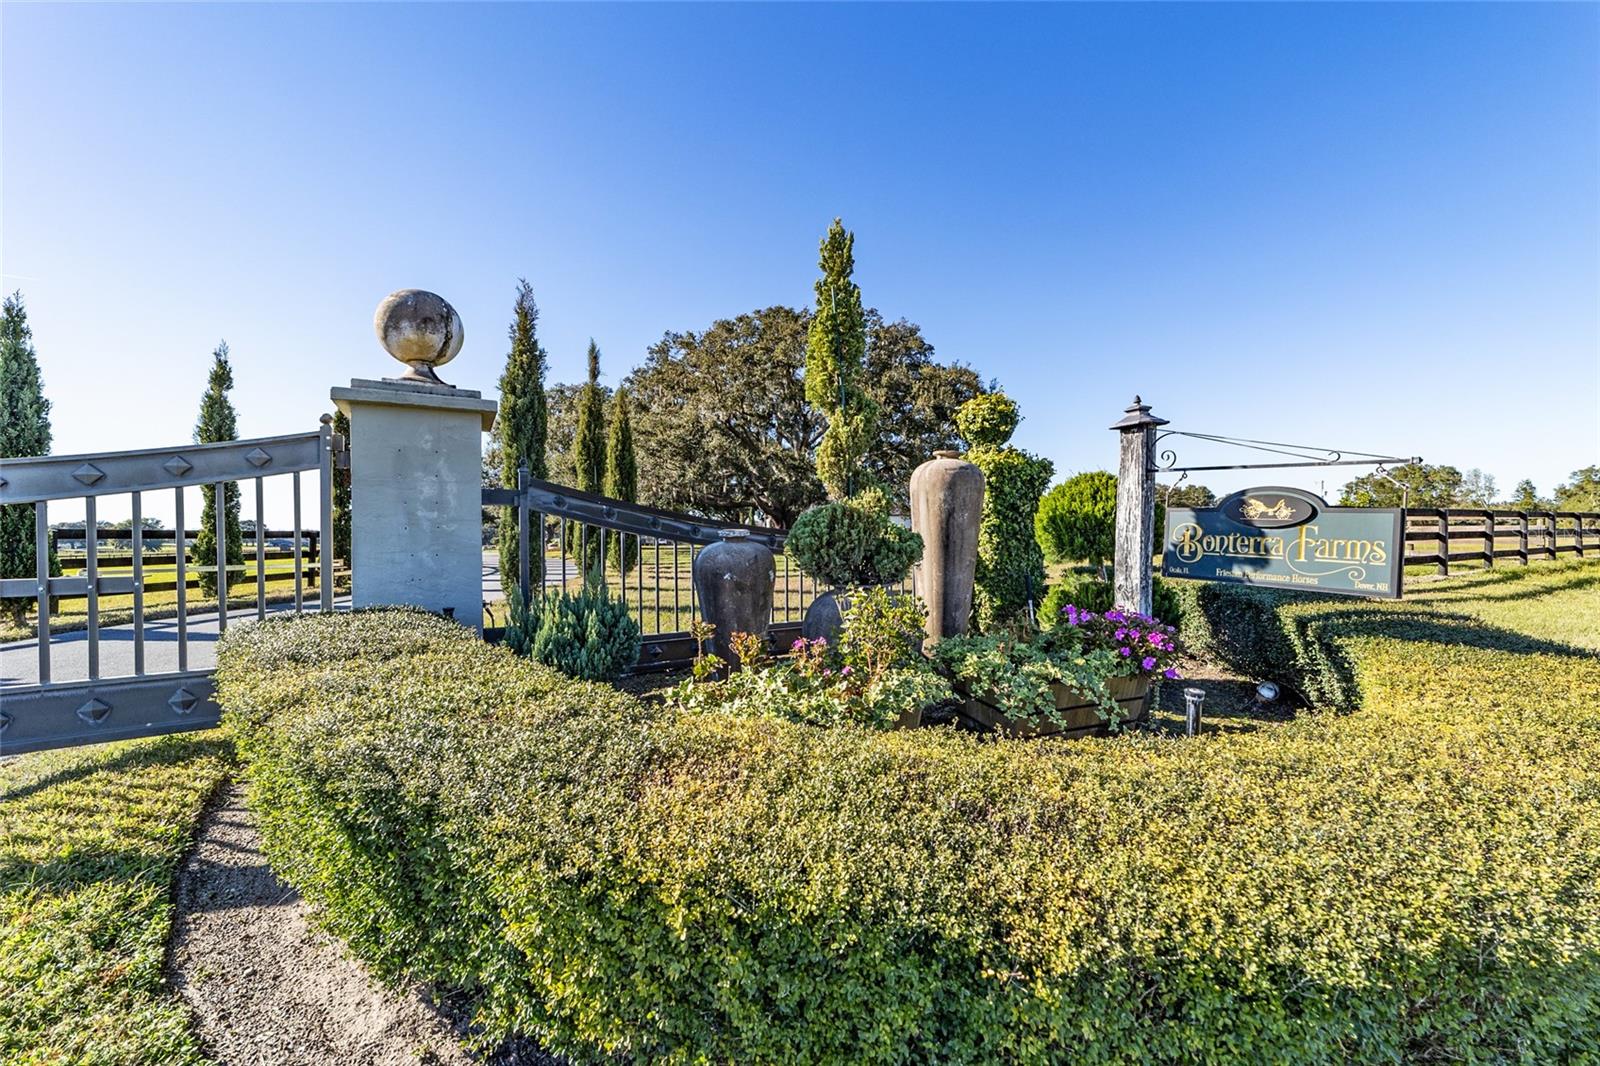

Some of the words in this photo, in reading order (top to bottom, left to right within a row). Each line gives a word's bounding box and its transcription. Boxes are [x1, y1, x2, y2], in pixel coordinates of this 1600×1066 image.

[1172, 522, 1284, 563] Bonterra
[1288, 525, 1387, 568] Farms
[1244, 569, 1290, 582] Performance
[1292, 574, 1319, 585] Horses
[1376, 582, 1388, 591] NH
